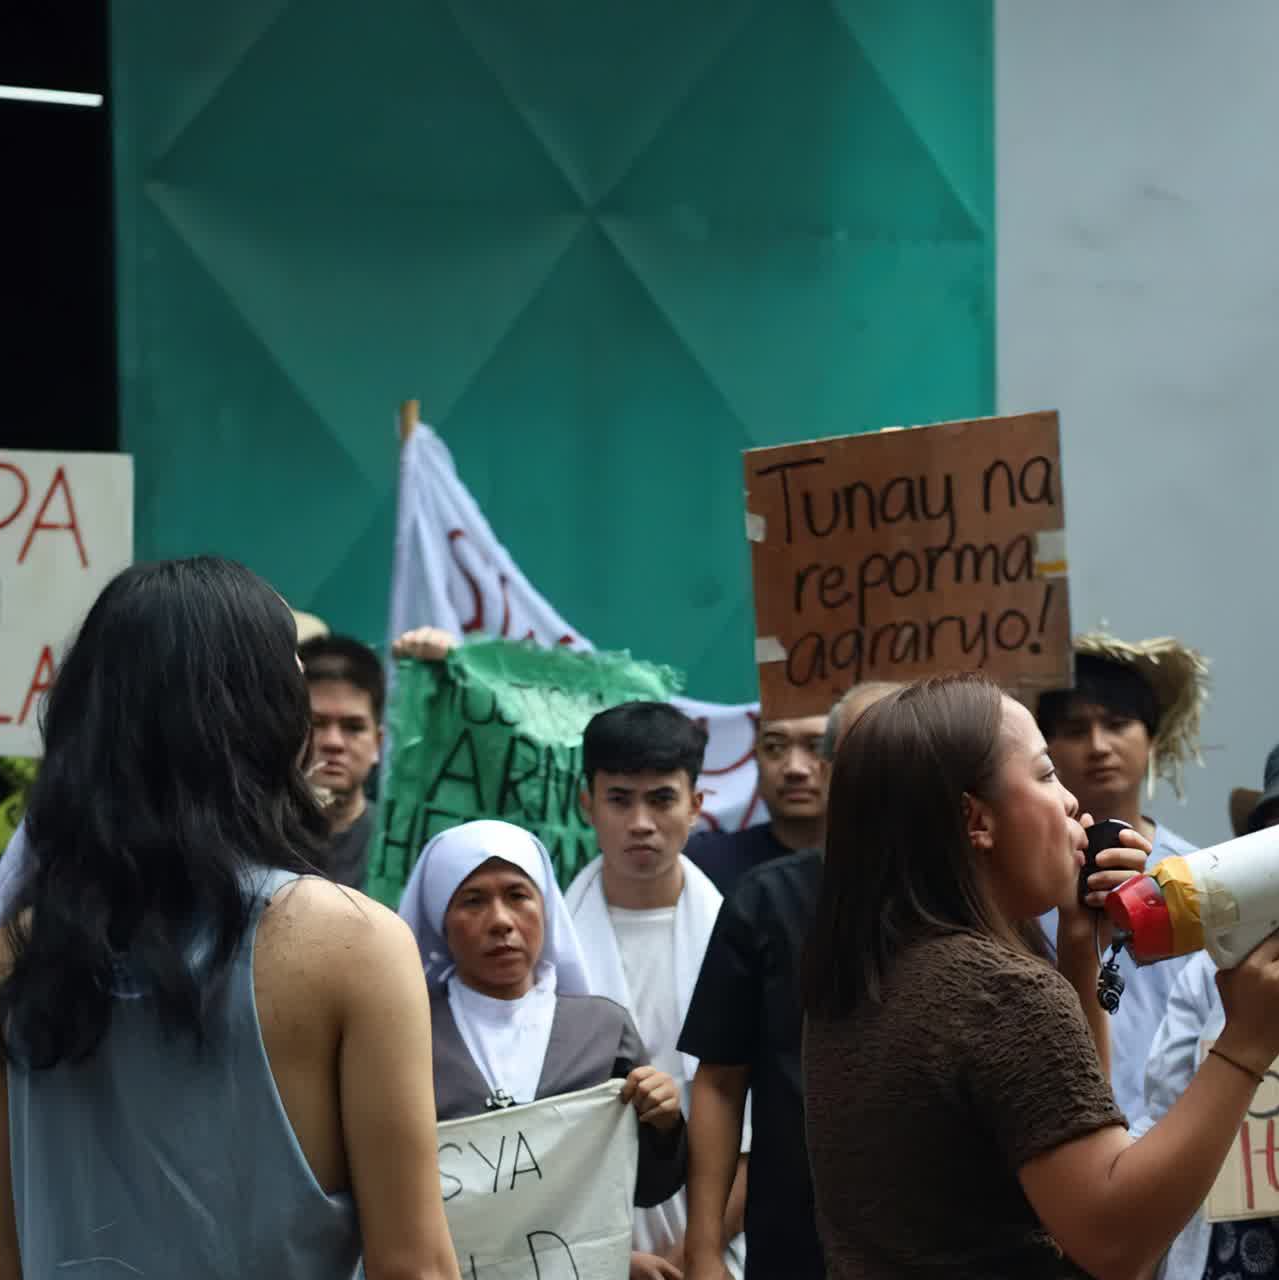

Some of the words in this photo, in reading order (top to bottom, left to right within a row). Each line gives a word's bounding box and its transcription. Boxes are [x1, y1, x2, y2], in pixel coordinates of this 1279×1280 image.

[756, 457, 956, 547] Tunay
[983, 455, 1054, 512] na
[794, 535, 1036, 626] reporma
[786, 584, 1054, 688] agraryo!
